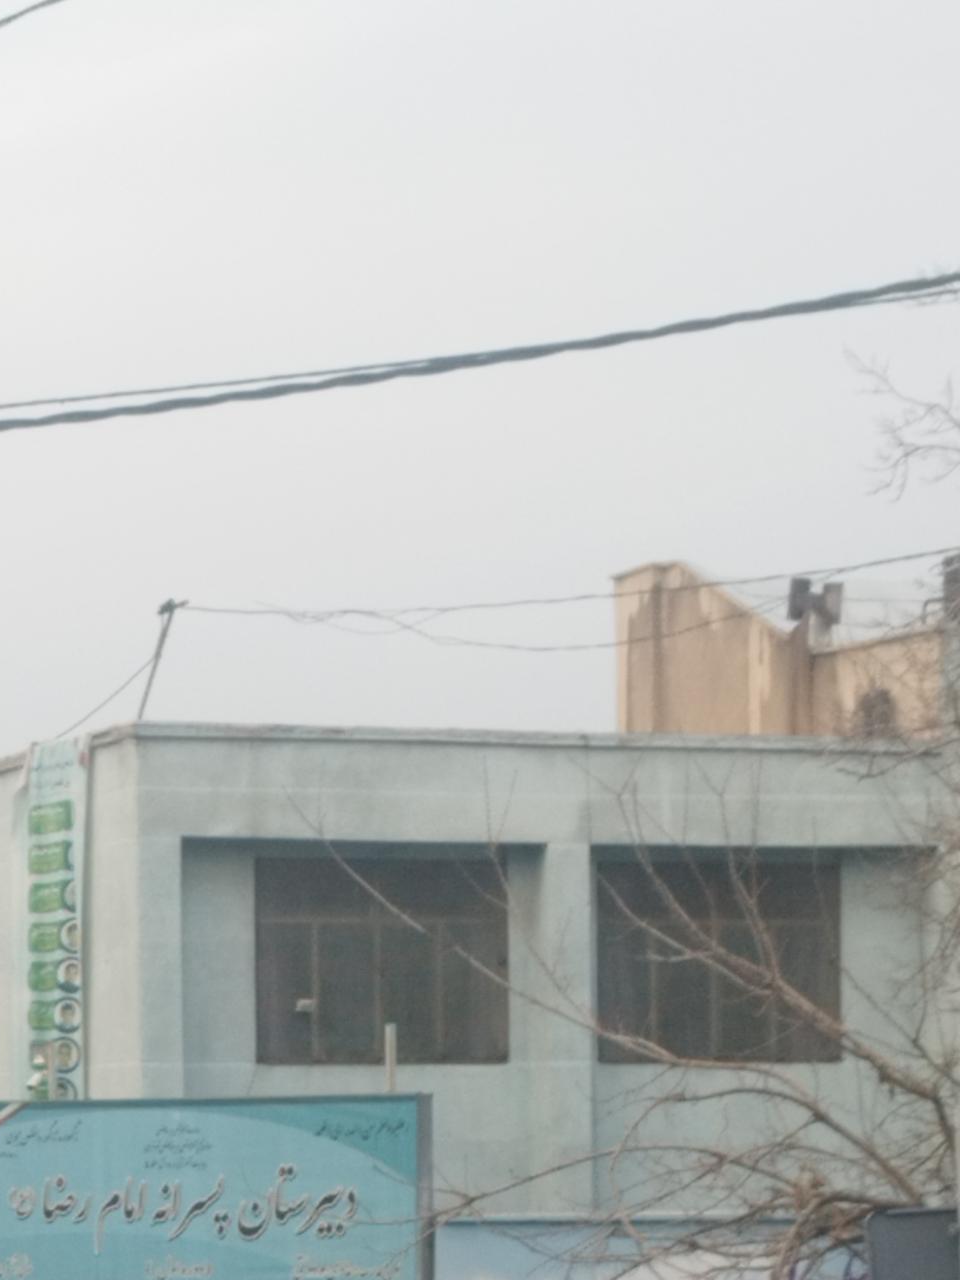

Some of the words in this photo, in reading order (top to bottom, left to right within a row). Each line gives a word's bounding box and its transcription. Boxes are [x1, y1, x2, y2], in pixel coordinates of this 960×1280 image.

[42, 1174, 91, 1224] رضا
[93, 1174, 147, 1255] امام
[152, 1172, 232, 1242] پسرانه
[237, 1162, 359, 1241] دبیرستان
